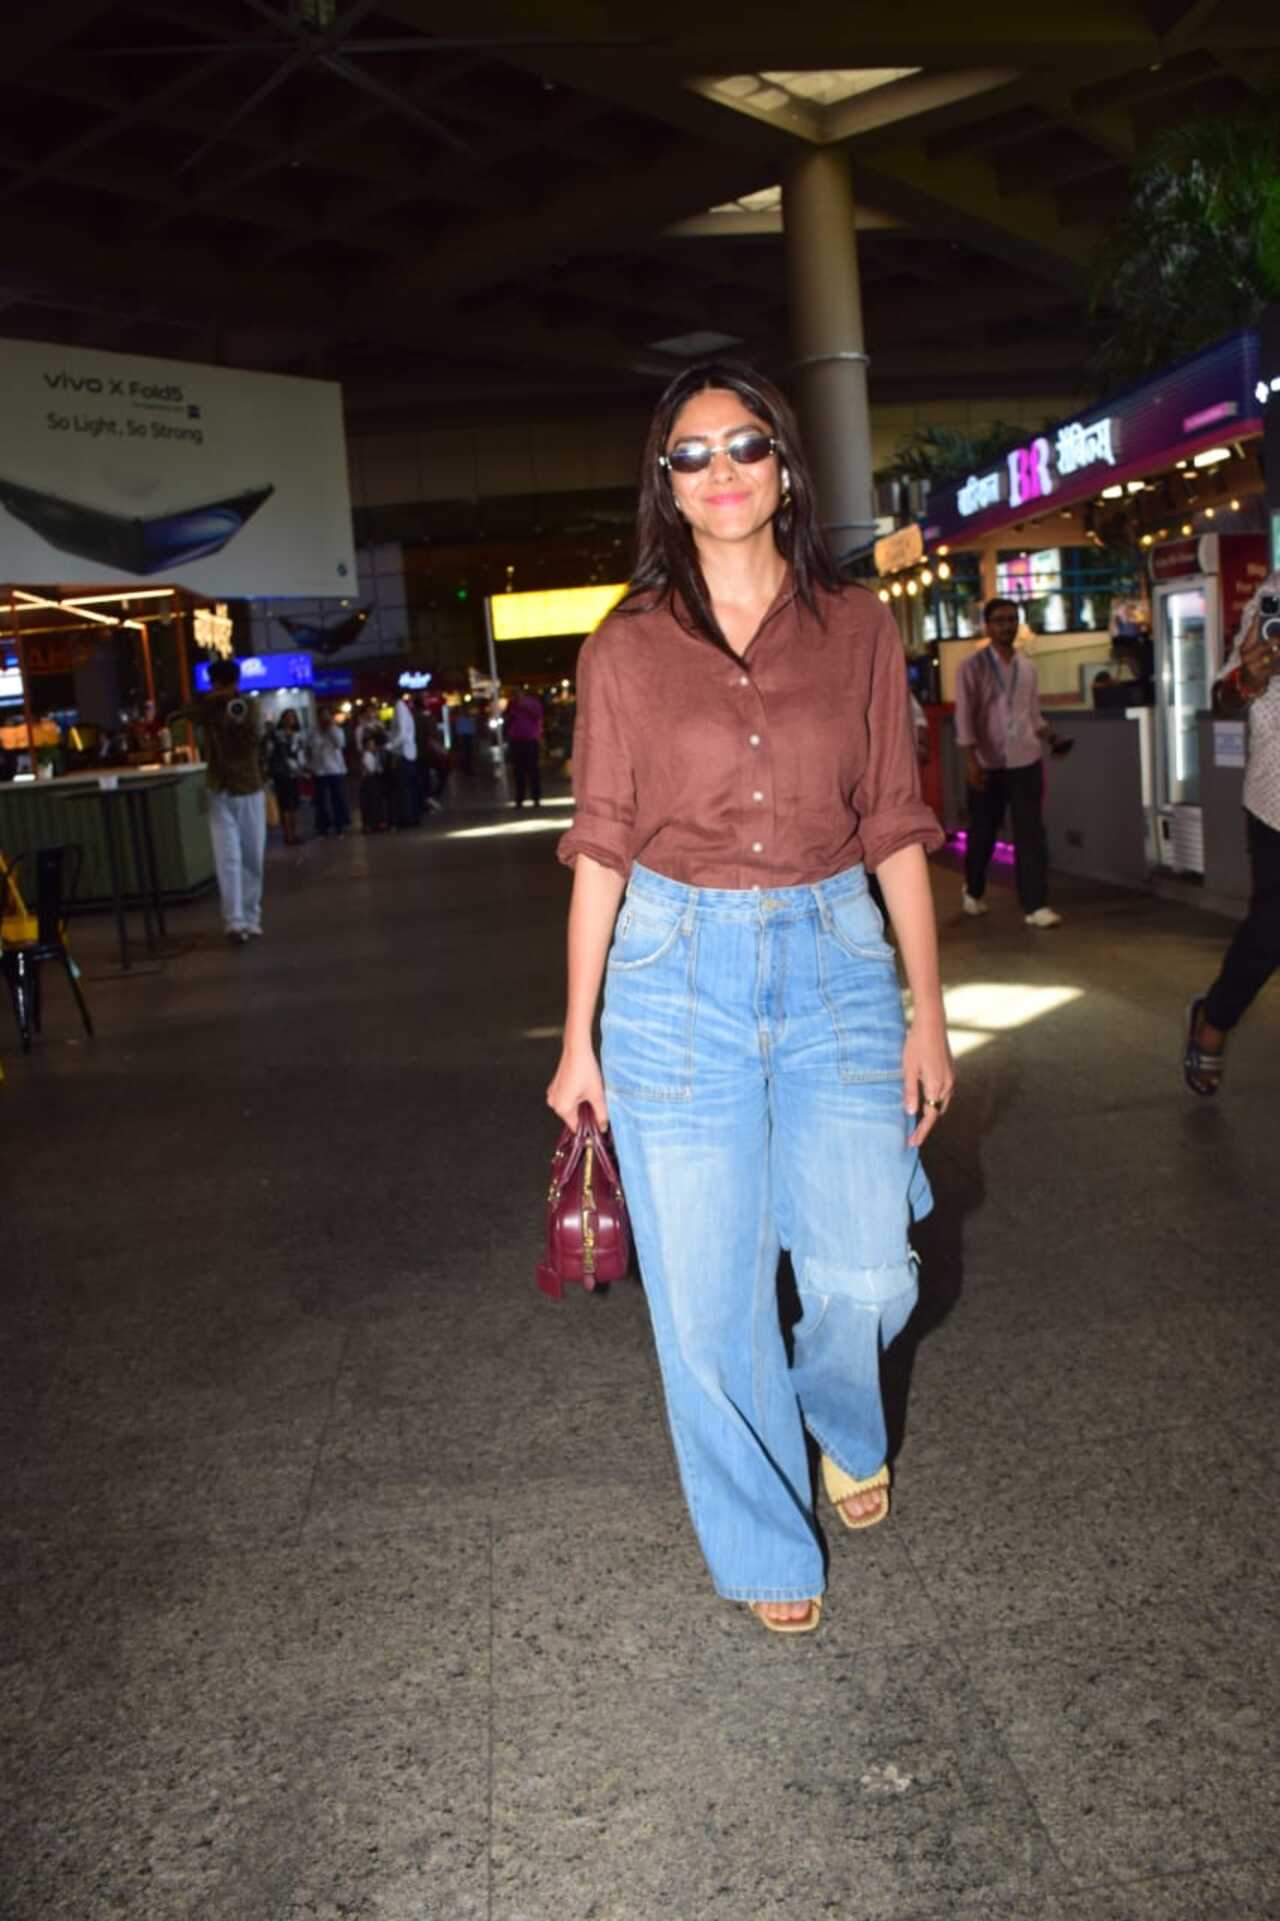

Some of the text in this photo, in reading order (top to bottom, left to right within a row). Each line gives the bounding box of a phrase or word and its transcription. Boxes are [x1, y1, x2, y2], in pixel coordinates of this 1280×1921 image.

[43, 370, 183, 402] vivo X Fold5
[47, 412, 204, 446] So Light, So Strong
